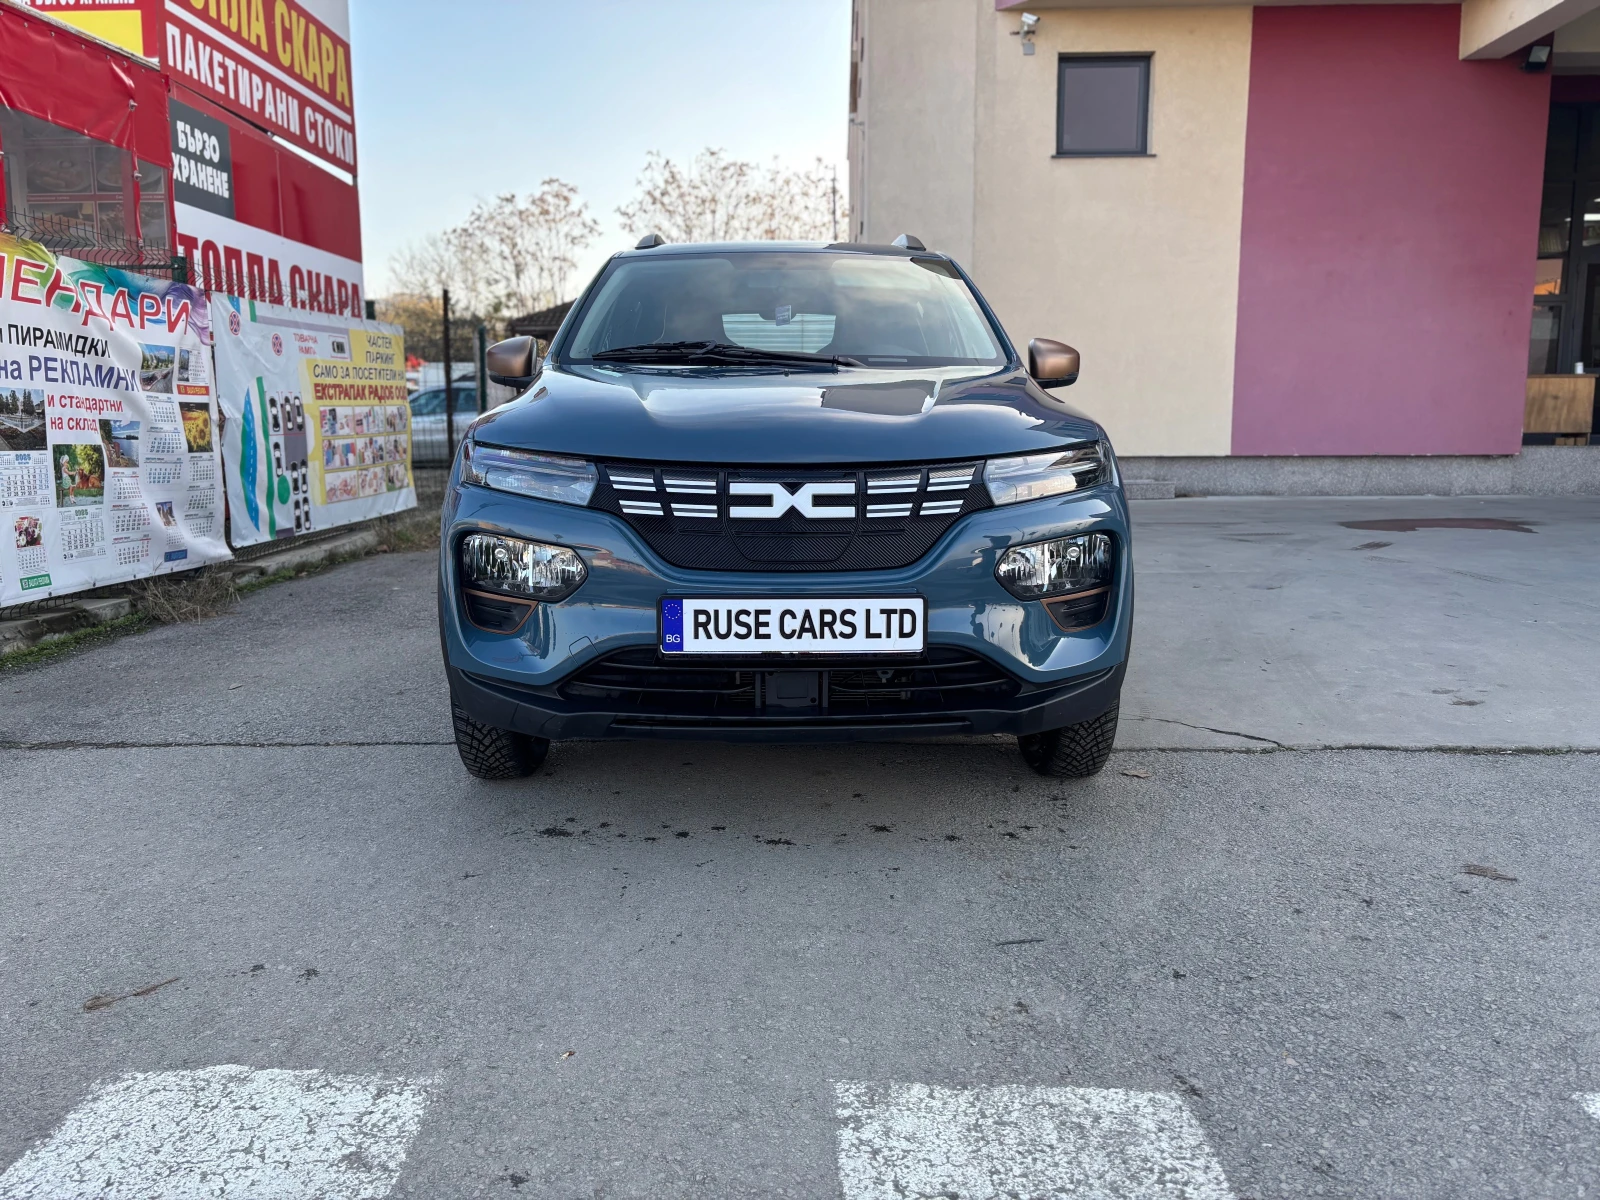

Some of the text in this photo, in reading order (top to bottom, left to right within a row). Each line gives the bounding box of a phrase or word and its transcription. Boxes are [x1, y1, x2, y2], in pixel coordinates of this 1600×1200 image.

[274, 0, 351, 108] СКАРА
[165, 22, 354, 166] ПАКЕТИРАНИ СТОКИ
[177, 120, 220, 163] БЪРЗО
[172, 152, 229, 198] ХРАНЕНЕ
[289, 264, 362, 319] СКАРА
[8, 323, 110, 358] ПИРАМИДКИ
[366, 334, 392, 349] ЧАСТЕН
[28, 354, 140, 392] РЕКЛАМНИ
[313, 364, 338, 379] САМО
[340, 367, 350, 379] ЗА
[352, 367, 397, 381] ПОСЕТИТЕЛИ
[366, 351, 395, 365] ПАРКИНГ
[47, 394, 123, 415] и стандартни
[313, 383, 367, 401] ЕКСТРАПАК
[50, 416, 99, 434] на склад
[665, 634, 681, 643] BG
[693, 608, 917, 640] RUSE CARS LTD
